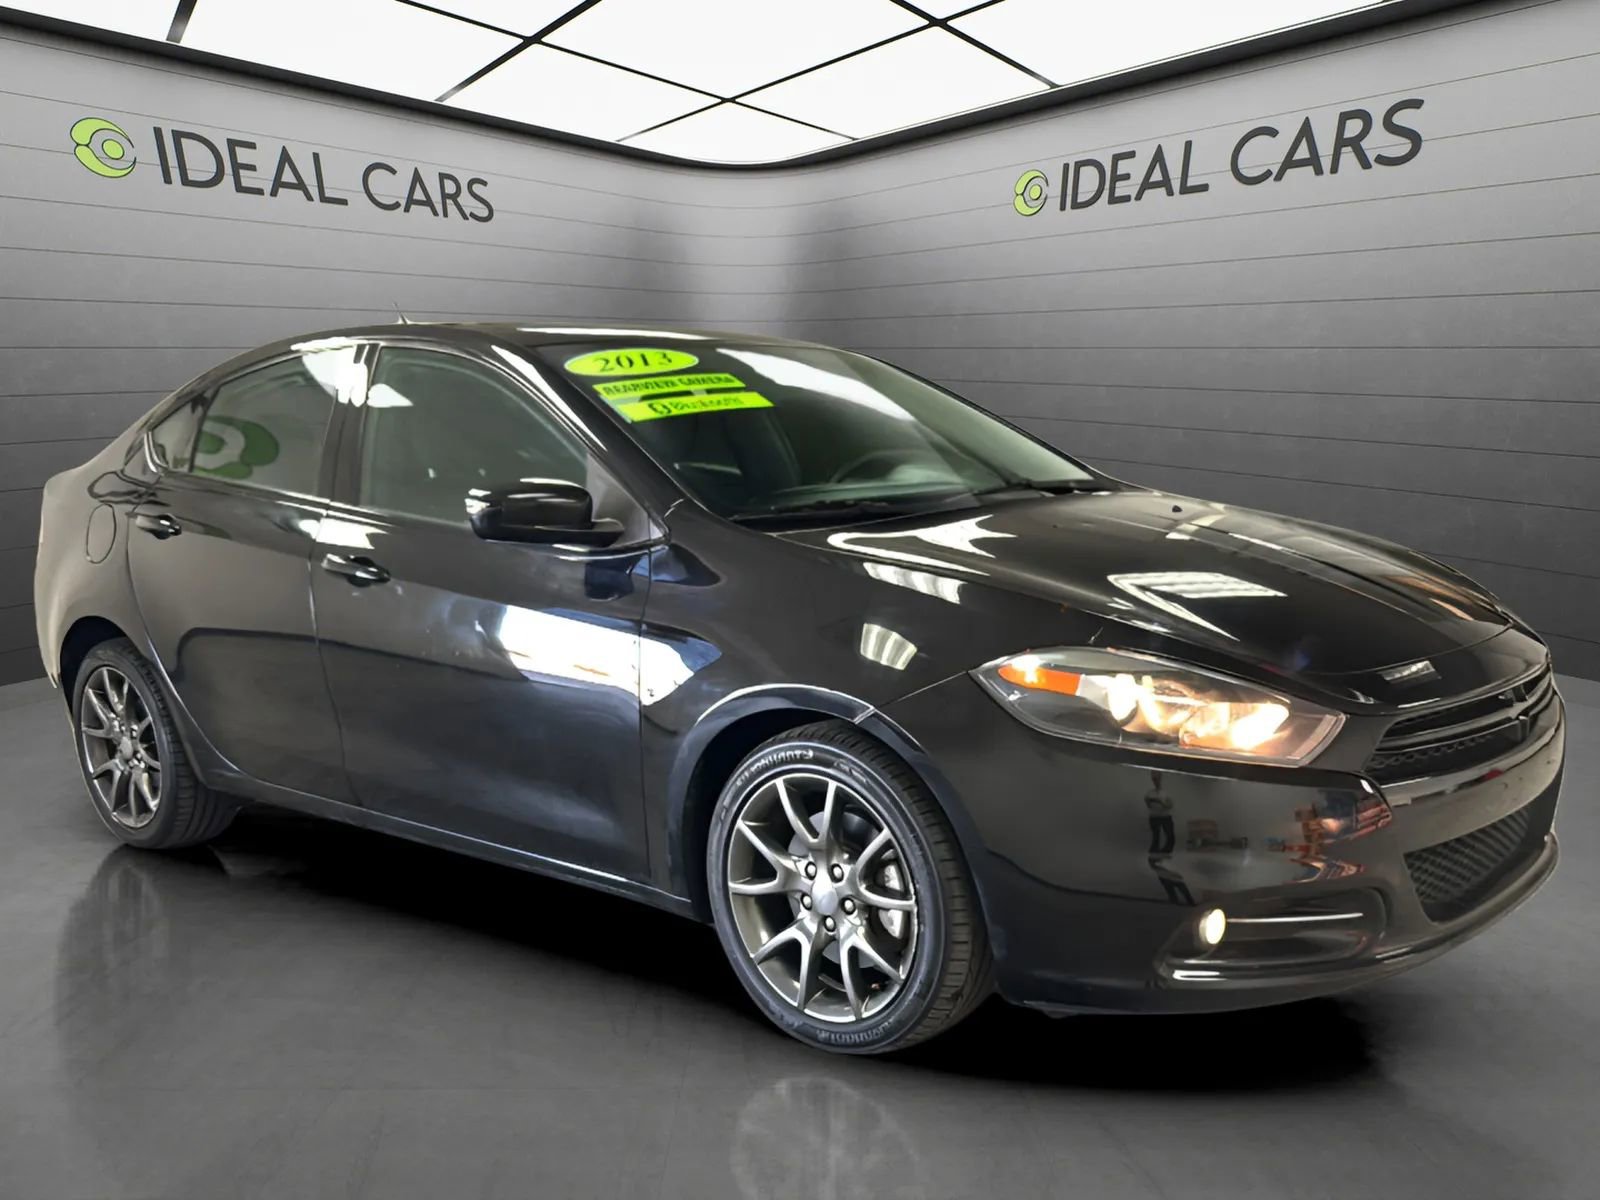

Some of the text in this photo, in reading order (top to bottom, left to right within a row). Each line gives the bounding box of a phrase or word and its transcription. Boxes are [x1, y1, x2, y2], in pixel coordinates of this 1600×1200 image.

[153, 126, 494, 223] IDEAL CARS
[1059, 98, 1425, 211] IDEAL CARS
[593, 351, 673, 373] 2013
